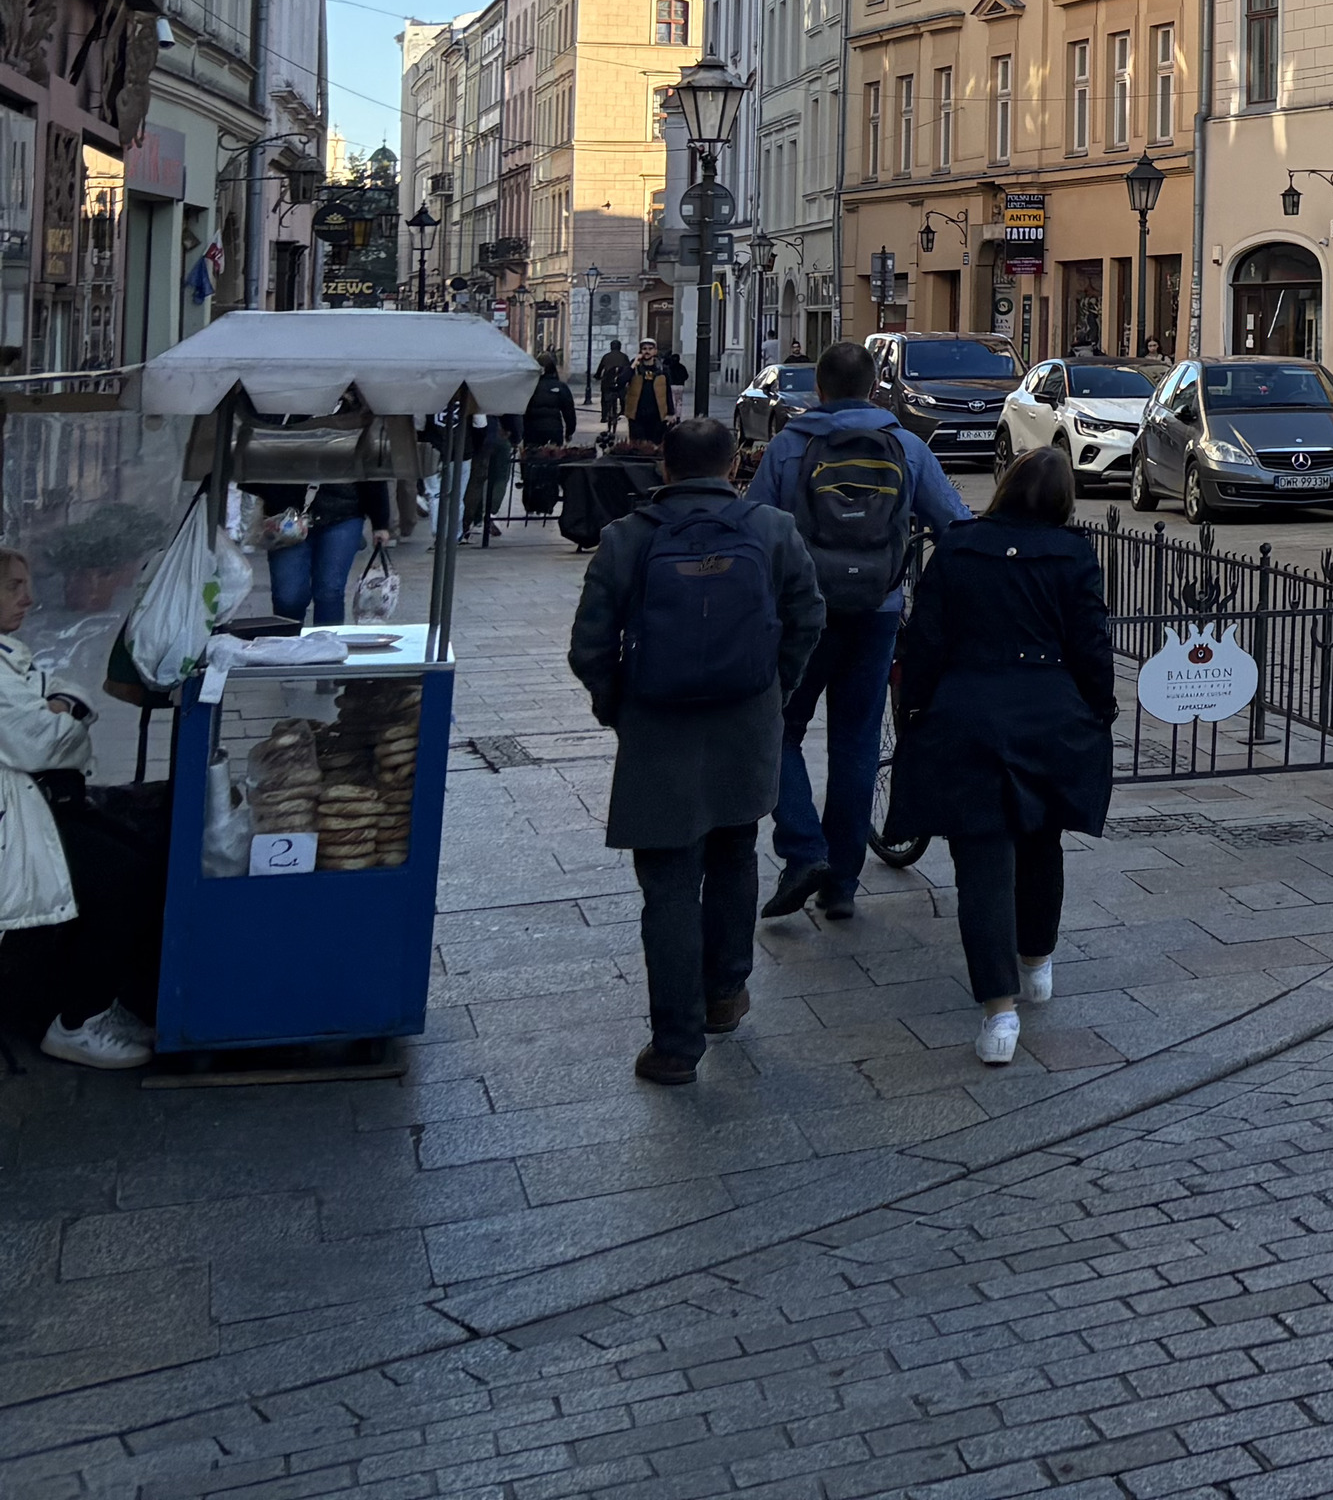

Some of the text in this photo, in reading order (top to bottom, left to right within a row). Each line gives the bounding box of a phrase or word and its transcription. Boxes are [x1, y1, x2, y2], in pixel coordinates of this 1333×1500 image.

[1008, 213, 1041, 222] ANTYKI
[1006, 227, 1044, 240] TATTOO
[1167, 668, 1232, 681] BALATON
